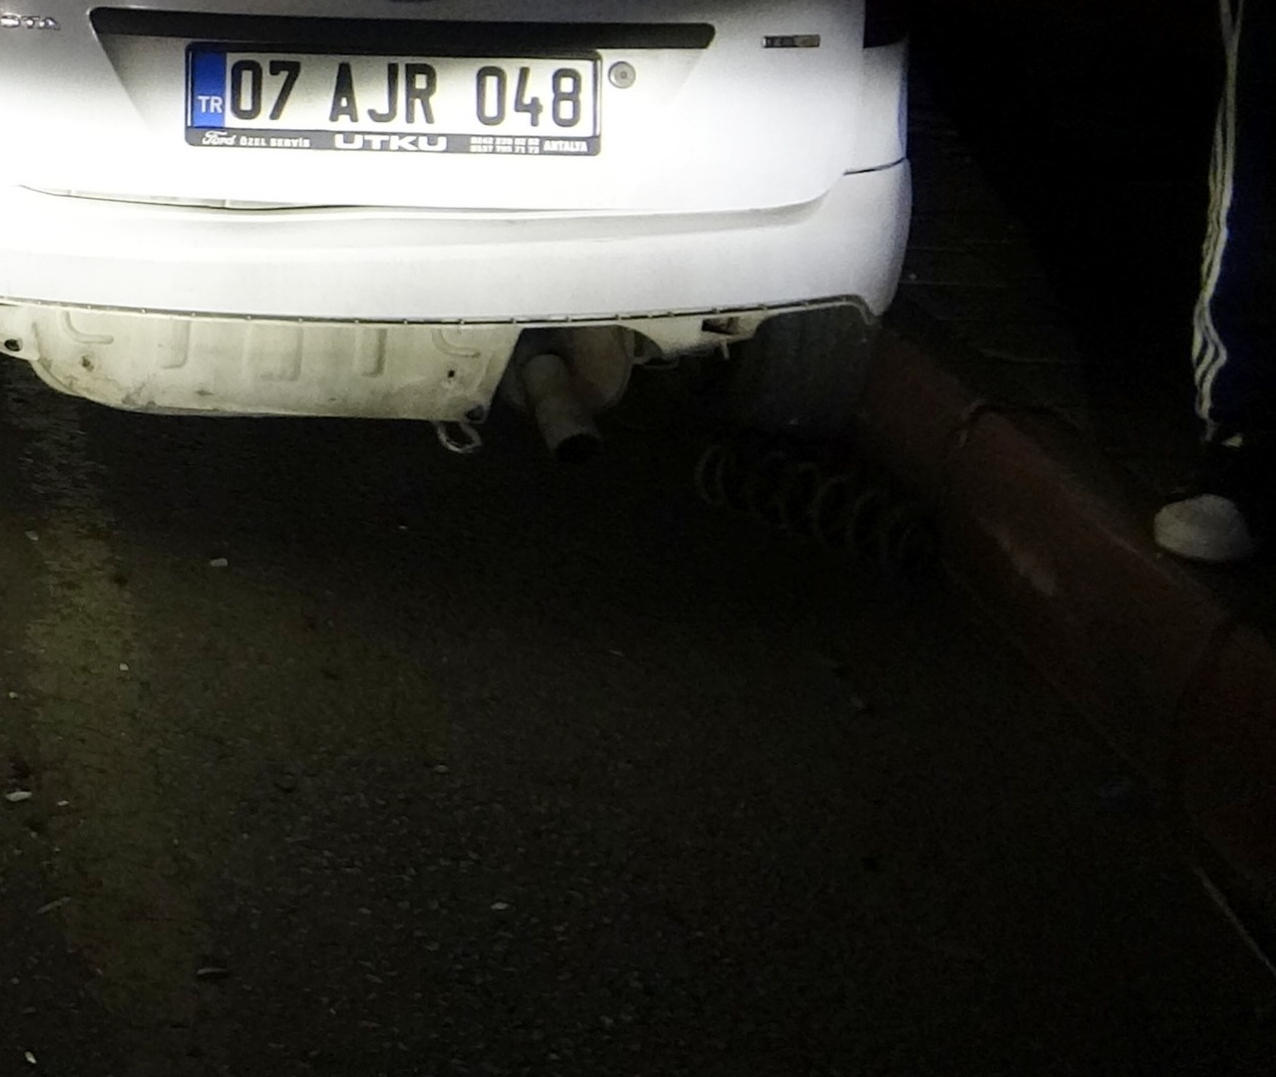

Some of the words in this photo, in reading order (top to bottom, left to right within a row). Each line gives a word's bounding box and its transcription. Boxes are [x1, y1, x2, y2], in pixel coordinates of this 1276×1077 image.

[230, 60, 301, 121] 07
[328, 62, 437, 124] AJR
[475, 65, 582, 128] 048
[197, 96, 223, 112] TR
[202, 131, 236, 145] Ford
[334, 133, 447, 152] UTKU
[543, 140, 588, 152] ANTALYA
